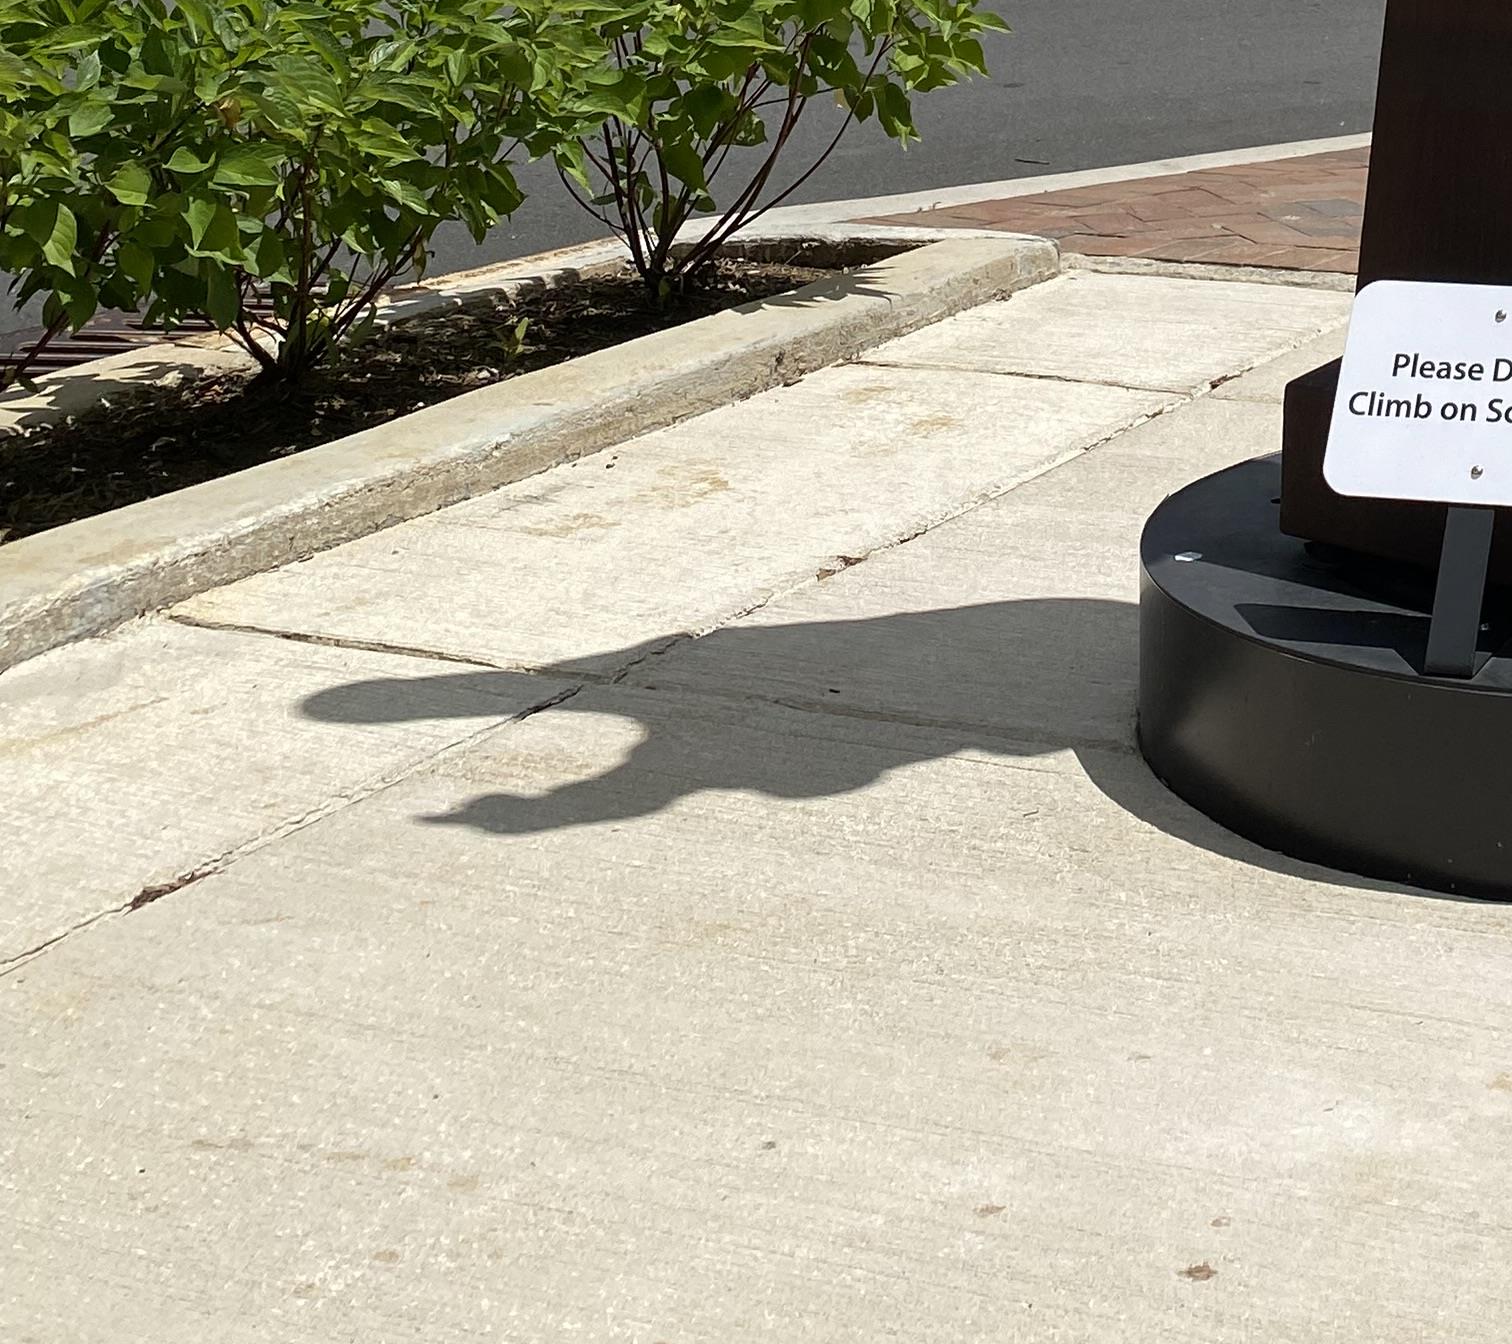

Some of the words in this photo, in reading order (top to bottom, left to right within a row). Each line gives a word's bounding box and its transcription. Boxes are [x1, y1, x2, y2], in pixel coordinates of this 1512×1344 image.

[1391, 352, 1484, 381] Please
[1348, 391, 1432, 419] Climb
[1440, 402, 1477, 423] on
